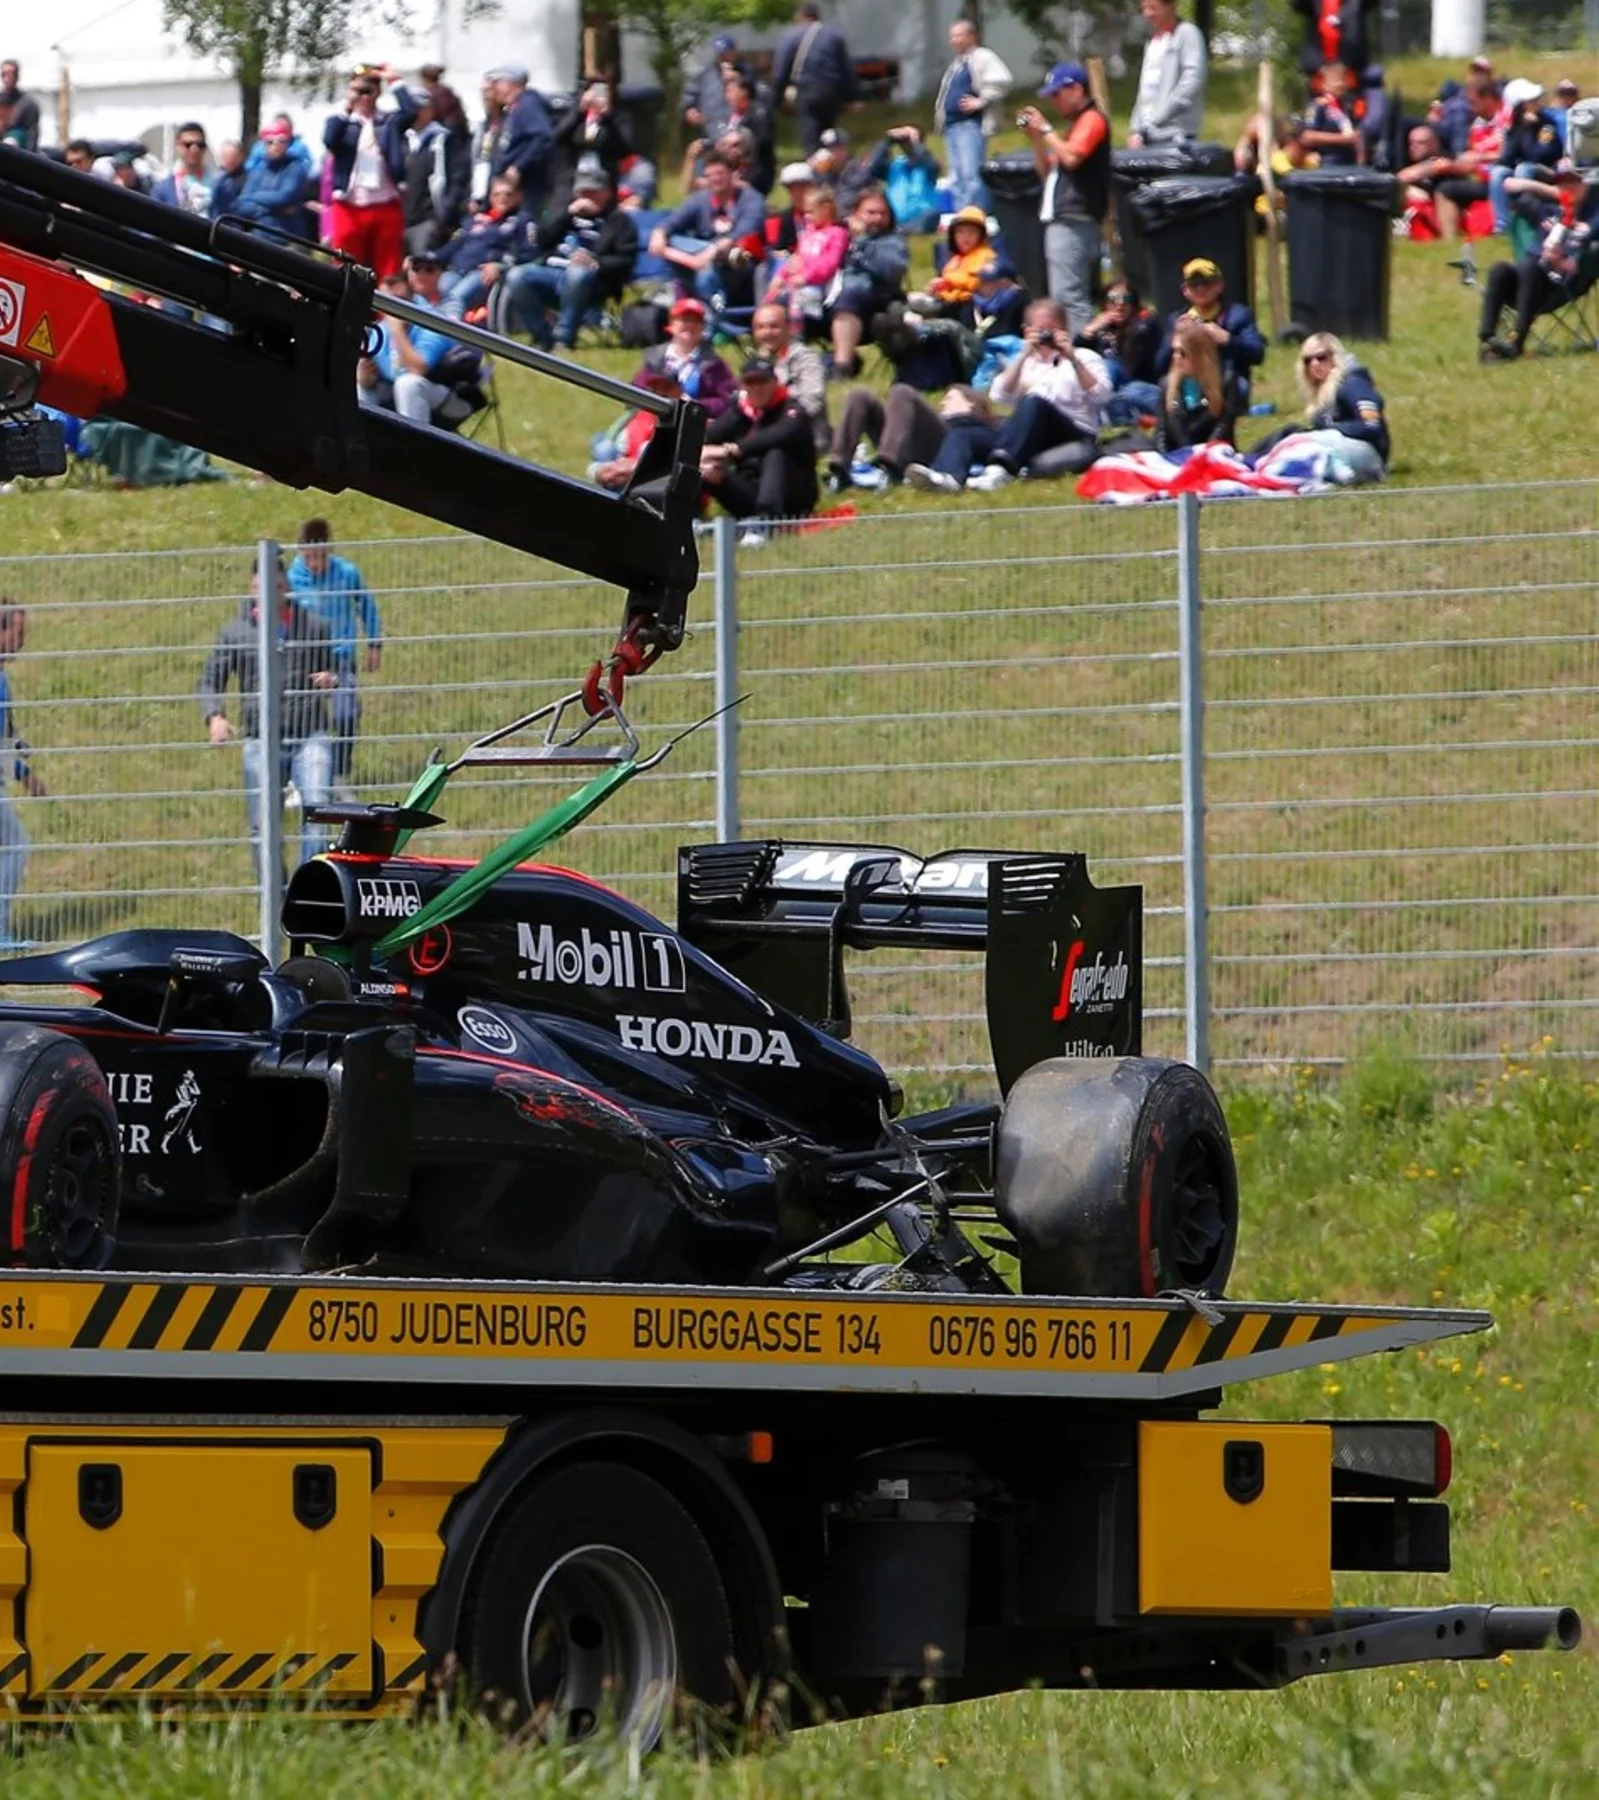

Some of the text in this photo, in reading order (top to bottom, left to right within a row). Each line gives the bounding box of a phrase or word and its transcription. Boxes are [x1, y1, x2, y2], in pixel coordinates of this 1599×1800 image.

[359, 894, 420, 917] KPMG
[516, 921, 671, 989] Mobil 1
[614, 1014, 801, 1069] HONDA
[308, 1299, 1133, 1362] 8750 JUDENBURG BURGGASSE 134 0676 96 766 11
